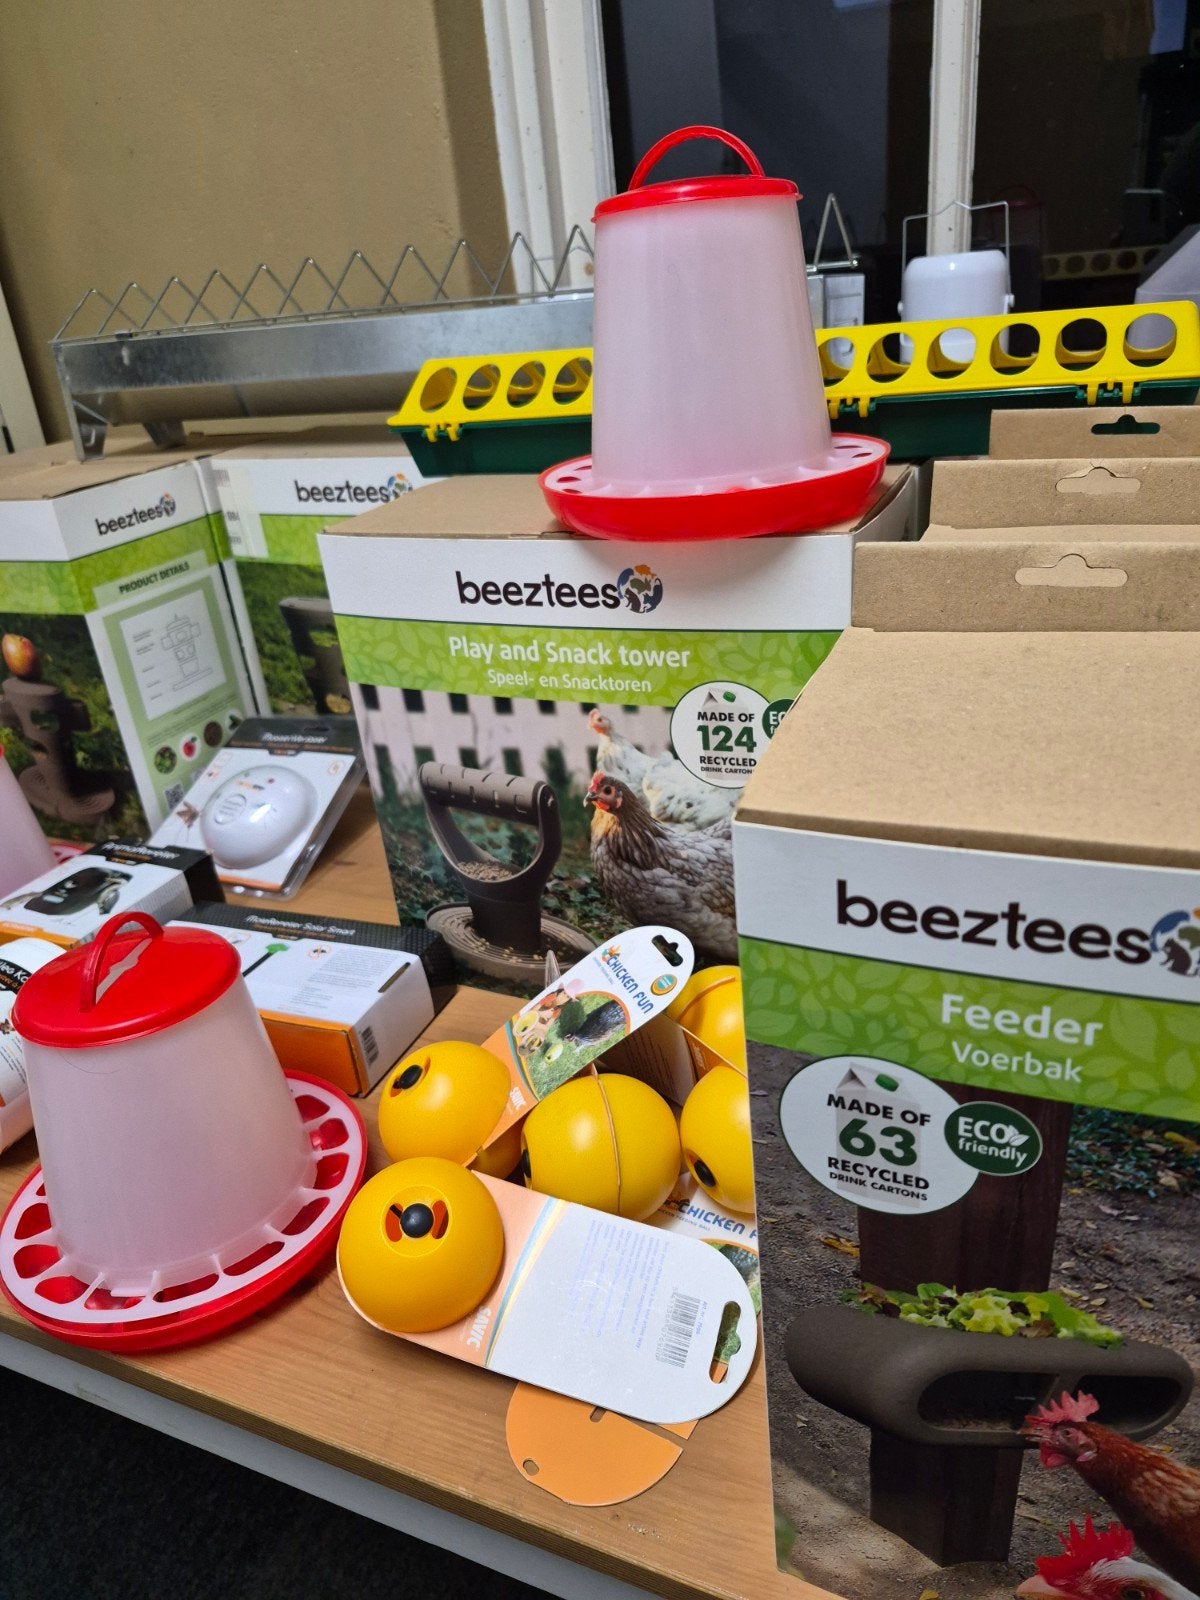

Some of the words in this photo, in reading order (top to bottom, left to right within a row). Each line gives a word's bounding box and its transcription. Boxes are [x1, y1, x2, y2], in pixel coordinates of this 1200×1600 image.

[295, 480, 390, 503] beeztees
[95, 505, 163, 536] beeztees
[119, 573, 158, 594] PRODUCT
[160, 561, 190, 579] DETAILS
[455, 570, 621, 609] beeztees
[449, 636, 493, 664] Play
[500, 640, 539, 661] and
[546, 642, 612, 665] Snack
[619, 645, 690, 668] tower
[487, 669, 534, 687] Speel-
[539, 677, 558, 688] en
[563, 675, 652, 692] Snacktoren
[697, 711, 734, 722] MADE
[738, 713, 755, 722] OF
[696, 724, 757, 753] 124
[699, 755, 757, 767] RECYCLED
[836, 878, 1151, 964] beeztees
[606, 956, 639, 993] CHICKEN
[632, 991, 654, 1014] FUN
[941, 993, 1103, 1047] Feeder
[951, 1040, 1082, 1083] Voerbak
[827, 1094, 893, 1120] MADE
[901, 1110, 931, 1127] OF
[839, 1117, 917, 1167] 63
[958, 1116, 1011, 1145] ECO
[958, 1138, 1028, 1168] friendly
[827, 1156, 930, 1190] RECYCLED
[829, 1171, 868, 1188] DRINK
[871, 1182, 928, 1201] CARTONS
[678, 1198, 745, 1235] CHICKEN
[466, 1306, 492, 1349] SAVIC
